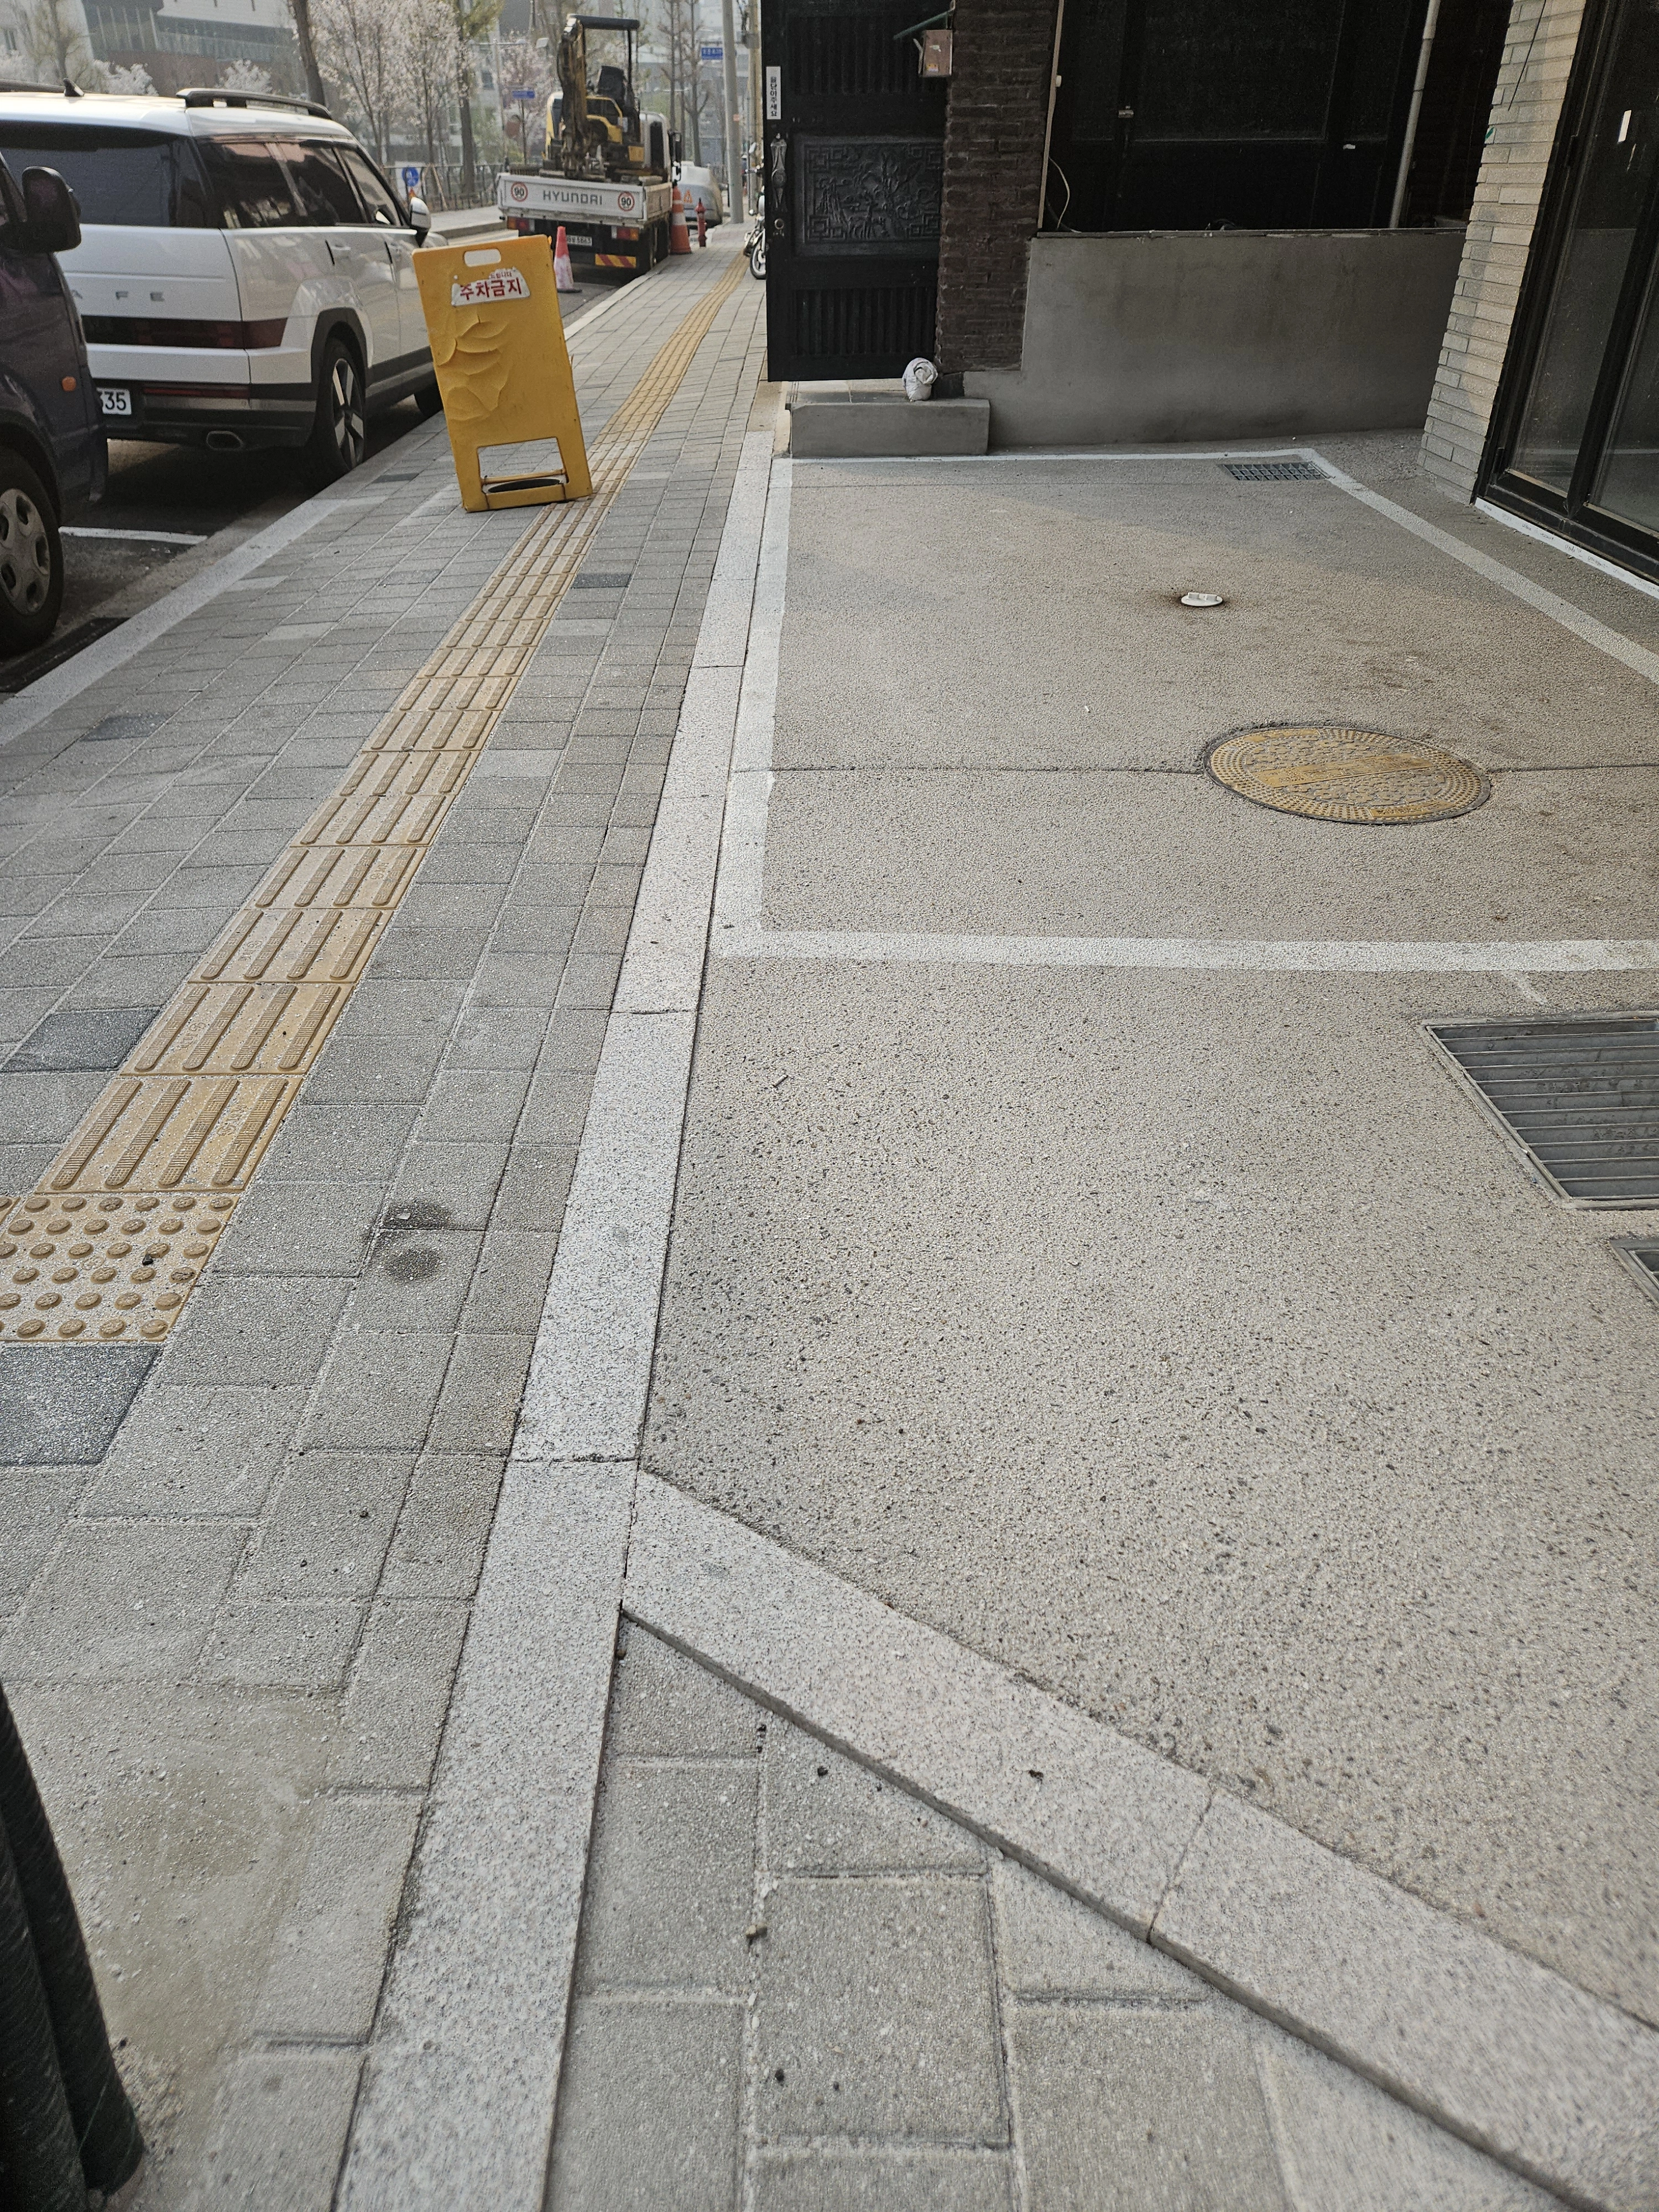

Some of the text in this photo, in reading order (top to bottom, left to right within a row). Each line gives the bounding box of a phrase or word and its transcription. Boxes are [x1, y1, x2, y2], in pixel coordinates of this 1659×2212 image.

[514, 186, 525, 197] 90
[542, 190, 603, 205] HYUNDAI
[621, 197, 632, 206] 90
[460, 277, 522, 301] 주차금지
[98, 390, 127, 411] 35
